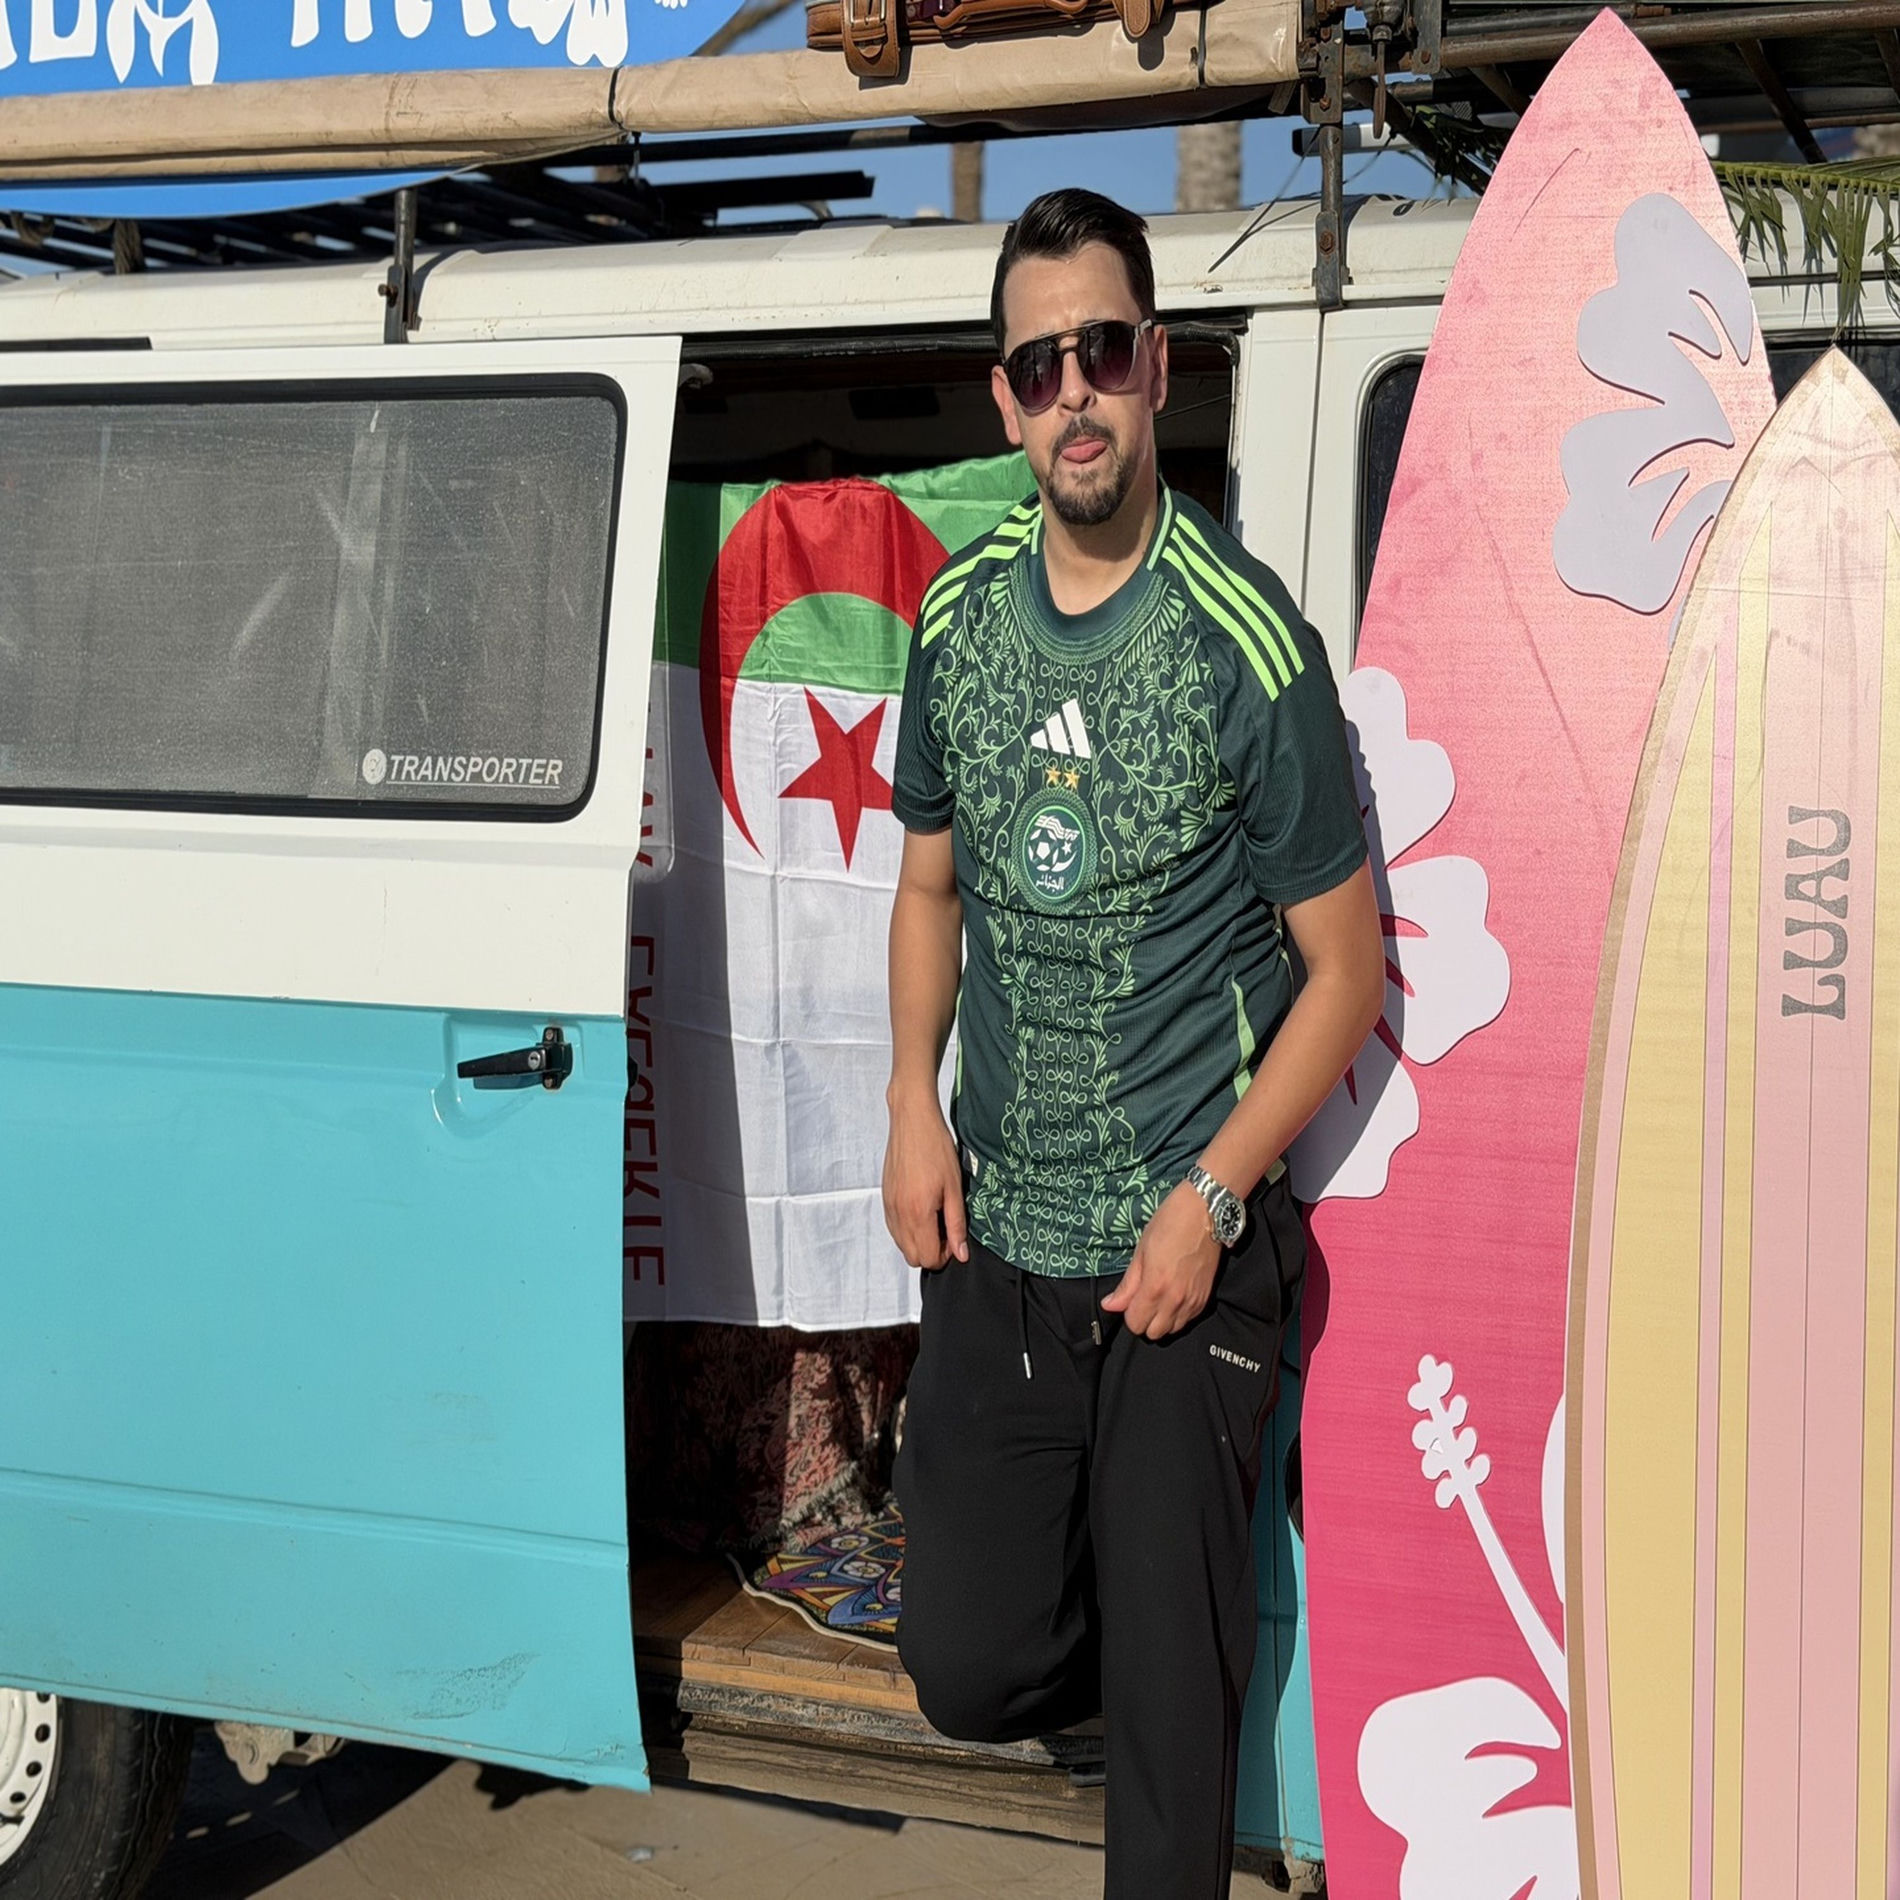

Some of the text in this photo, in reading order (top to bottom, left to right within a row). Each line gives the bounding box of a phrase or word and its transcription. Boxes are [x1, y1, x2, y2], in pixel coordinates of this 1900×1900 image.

[389, 755, 563, 785] TRANSPORTER
[1781, 805, 1852, 1021] LUAU
[1209, 1344, 1261, 1373] GIVENCHY
